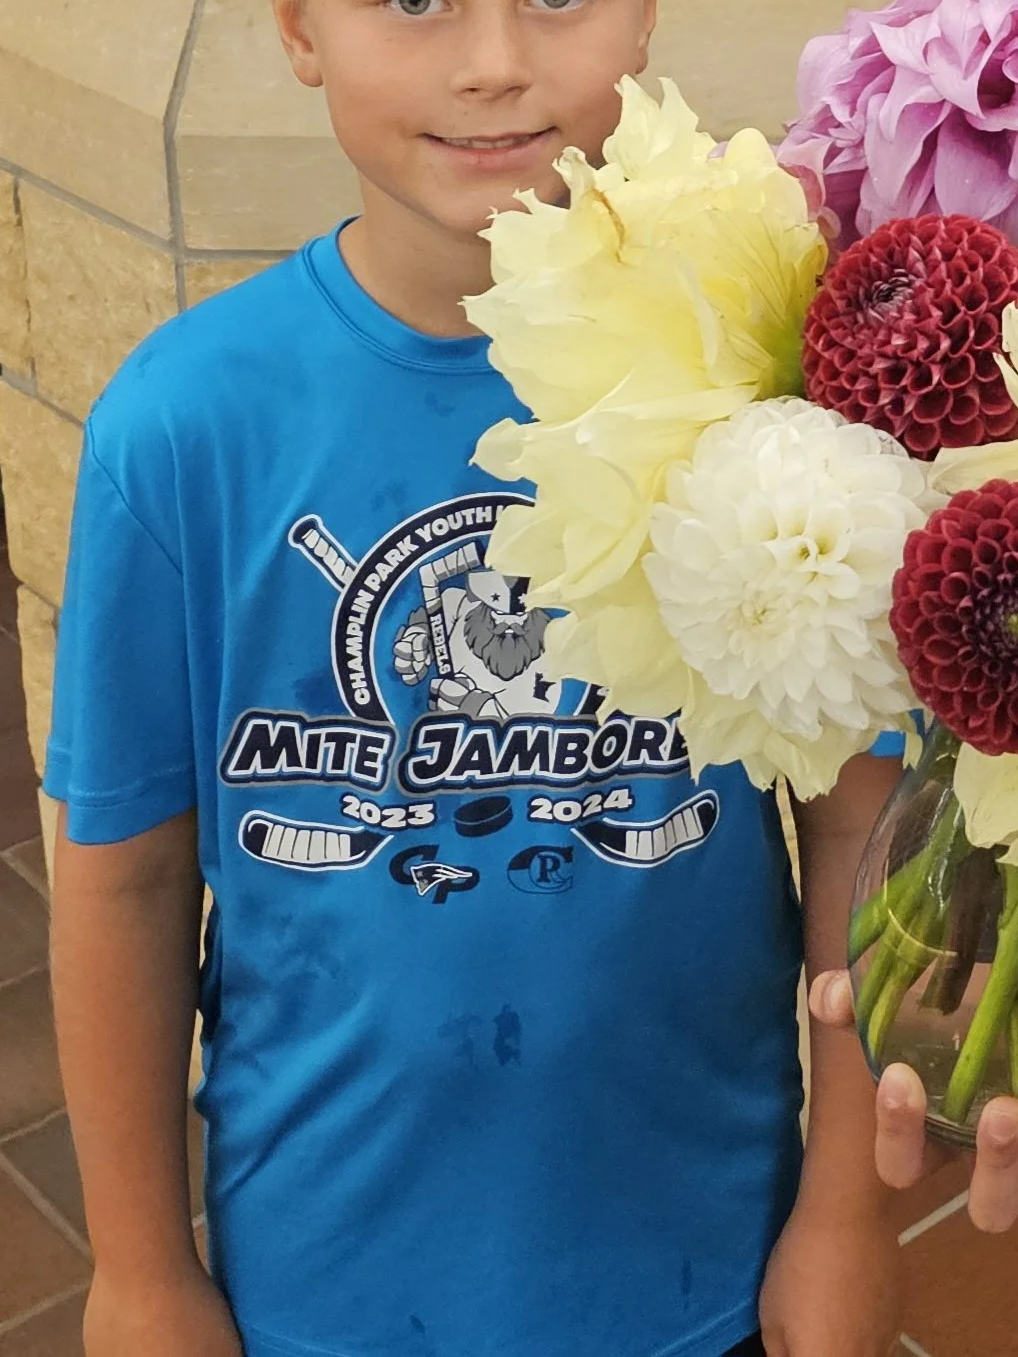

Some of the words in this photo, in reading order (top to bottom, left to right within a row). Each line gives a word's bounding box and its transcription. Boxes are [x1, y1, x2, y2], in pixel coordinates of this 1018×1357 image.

[345, 588, 376, 706] CHAMPLIN
[363, 534, 420, 592] PARK
[415, 505, 493, 543] YOUTH
[429, 612, 452, 675] REBELS
[228, 719, 391, 783] MITE
[407, 715, 689, 787] JAMBORE
[341, 794, 435, 829] 2023
[530, 788, 633, 823] 2024
